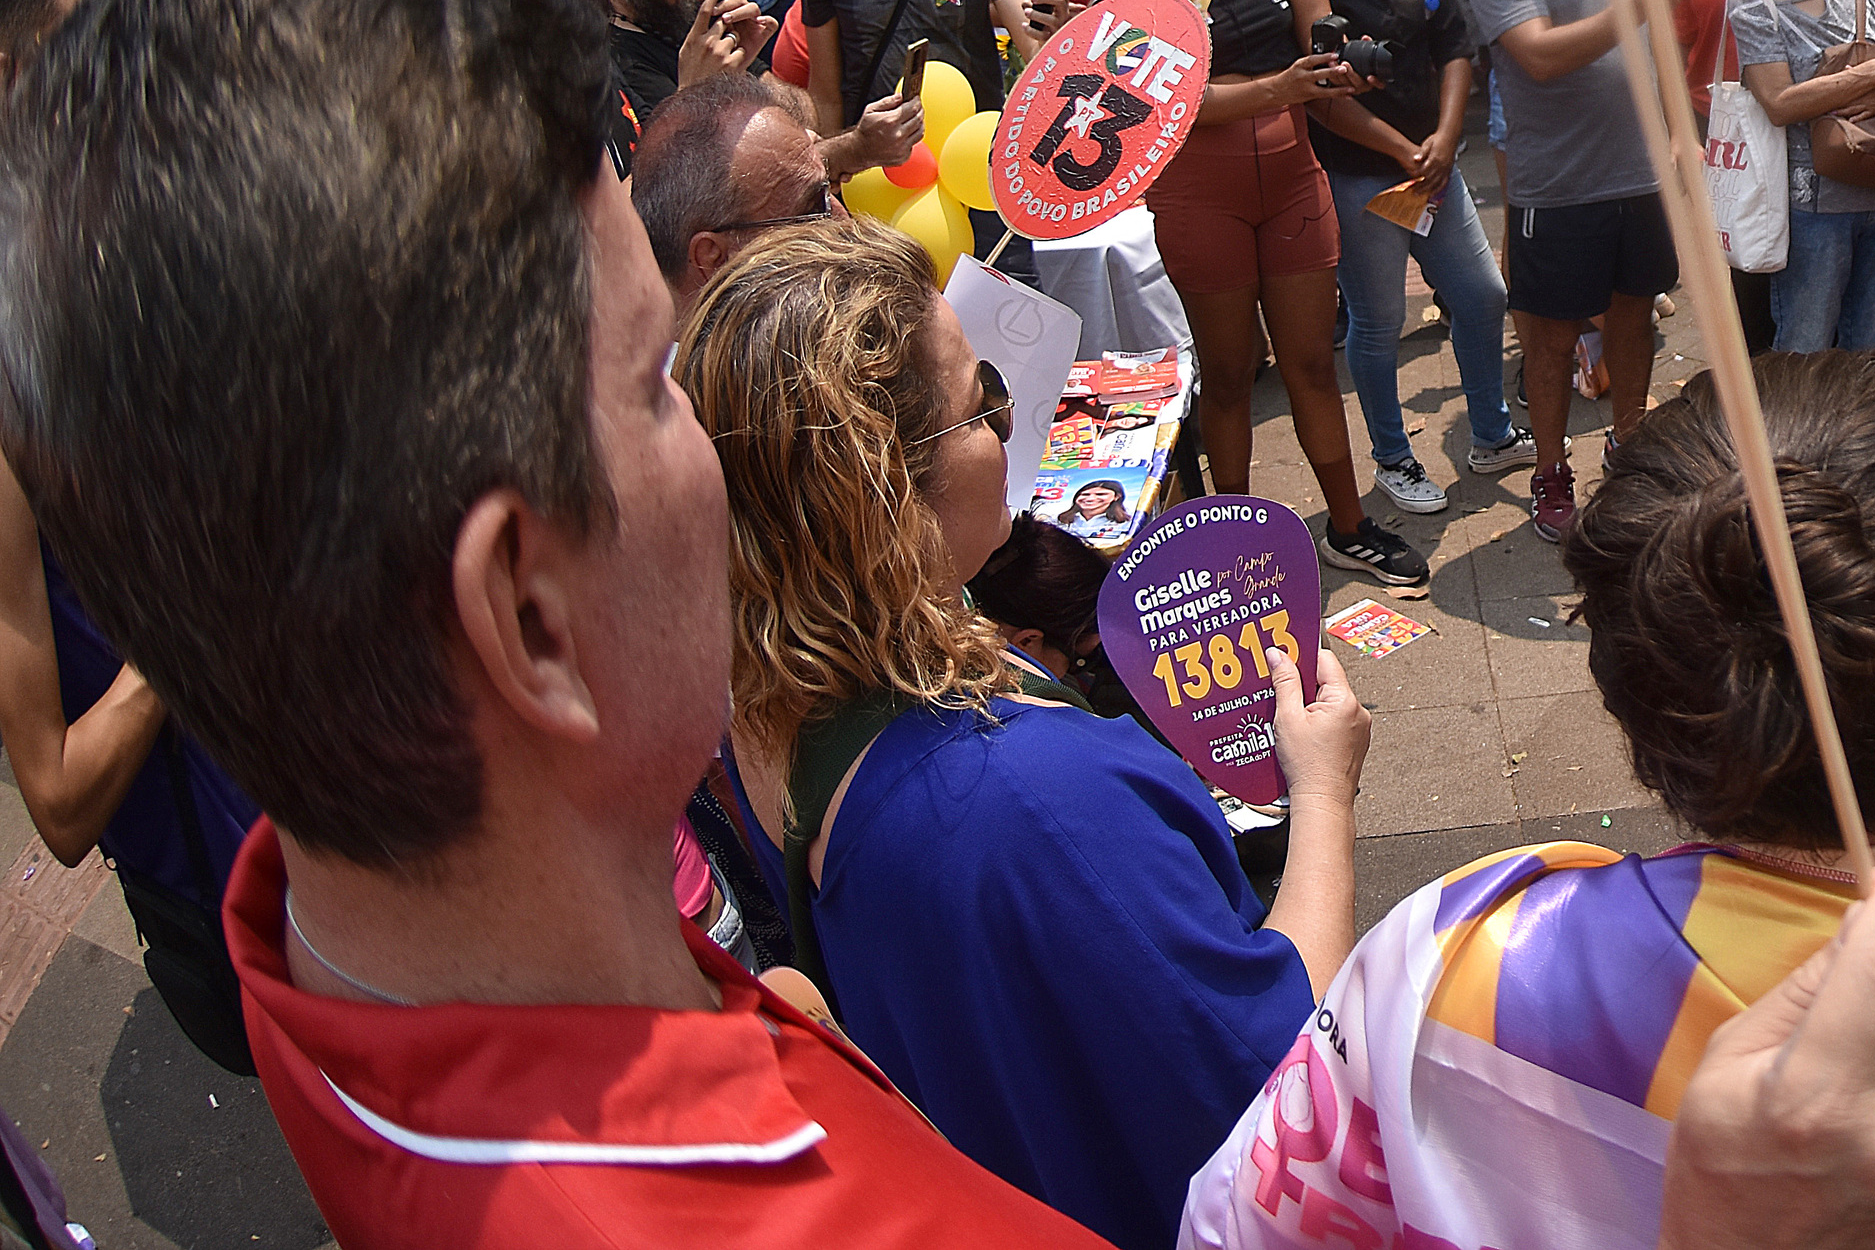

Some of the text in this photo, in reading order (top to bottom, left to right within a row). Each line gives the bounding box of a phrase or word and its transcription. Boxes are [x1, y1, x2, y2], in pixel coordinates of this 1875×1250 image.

[1086, 10, 1198, 105] VOTE
[1004, 37, 1188, 223] O PARTIDO DO POVO BRASILEIRO
[1028, 73, 1155, 192] 13
[1079, 106, 1096, 123] PT
[1117, 505, 1269, 582] ENCONTRE O PONTO G
[1235, 551, 1275, 582] Campo
[1134, 568, 1233, 613] Giselle por
[1149, 592, 1284, 652] PARA VEREADORA
[1152, 608, 1300, 709] 13813
[1192, 710, 1204, 722] 14
[1204, 705, 1218, 718] DE
[1208, 732, 1244, 747] PREFEITA
[1235, 756, 1255, 767] ZECA
[1262, 750, 1271, 759] PT
